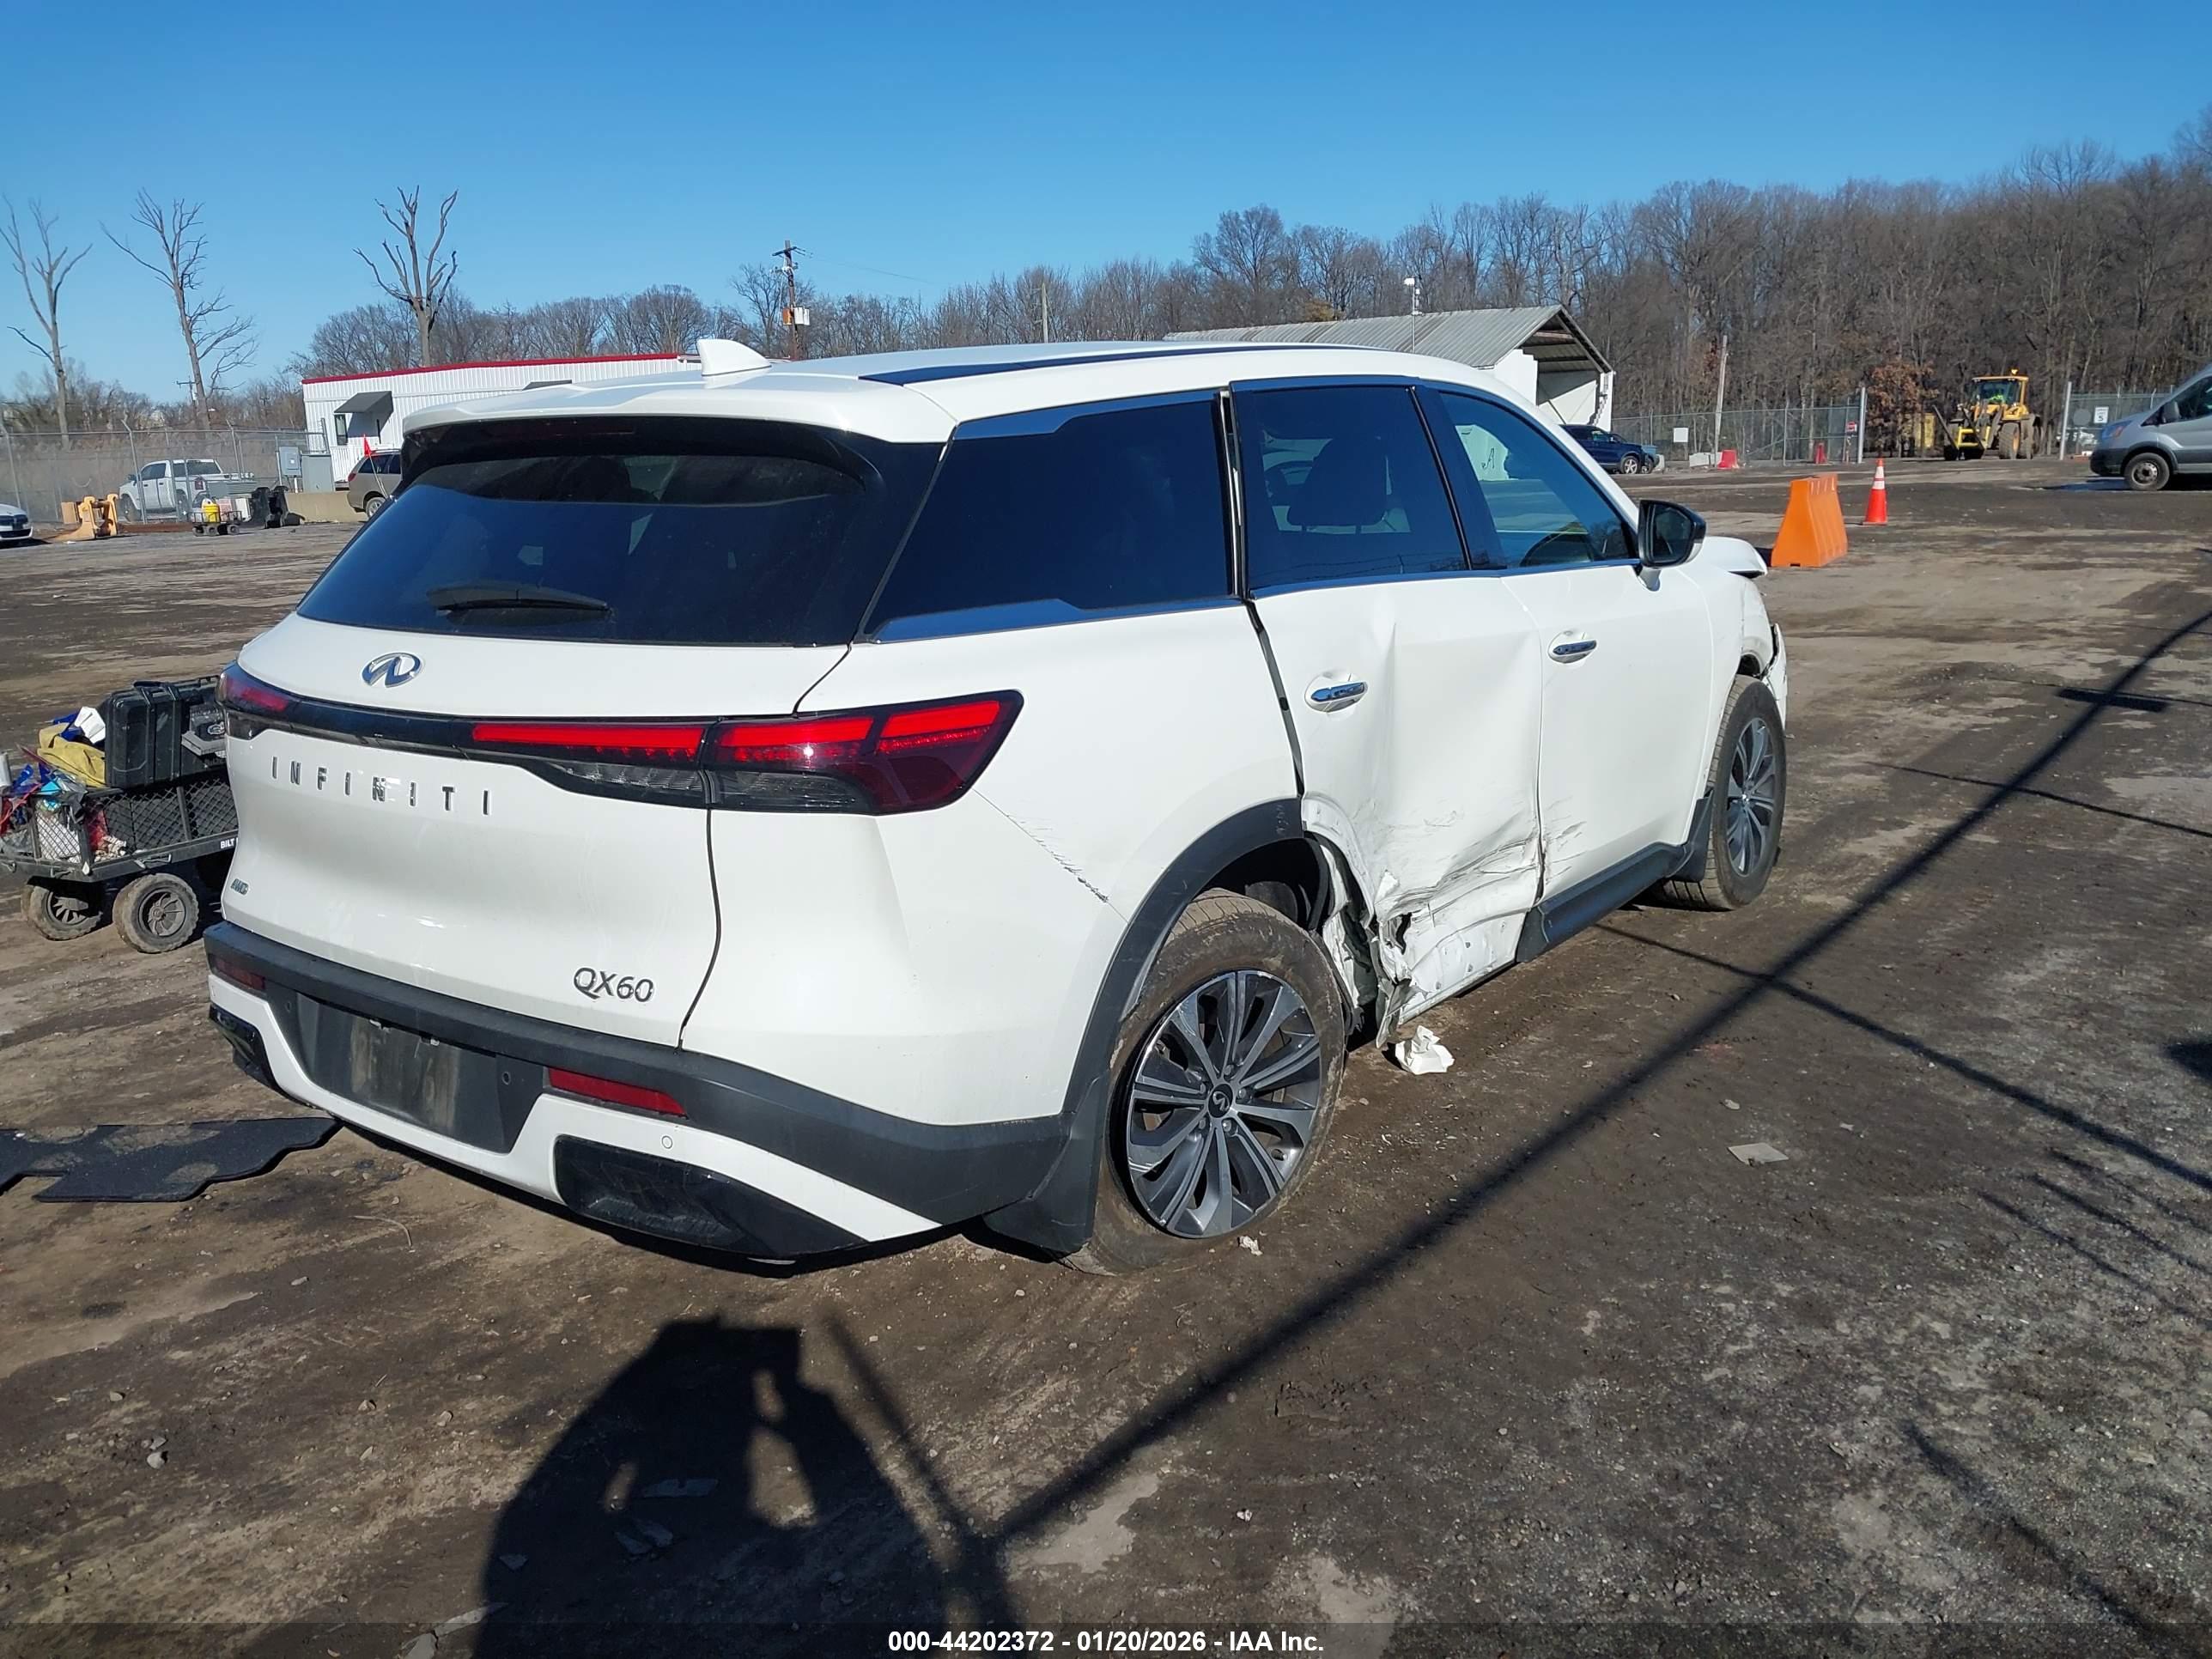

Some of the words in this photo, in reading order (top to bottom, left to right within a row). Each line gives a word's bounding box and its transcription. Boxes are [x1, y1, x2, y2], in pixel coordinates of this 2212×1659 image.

[271, 756, 489, 816] INFINITI
[220, 838, 234, 849] BILT
[573, 967, 654, 1003] QX60
